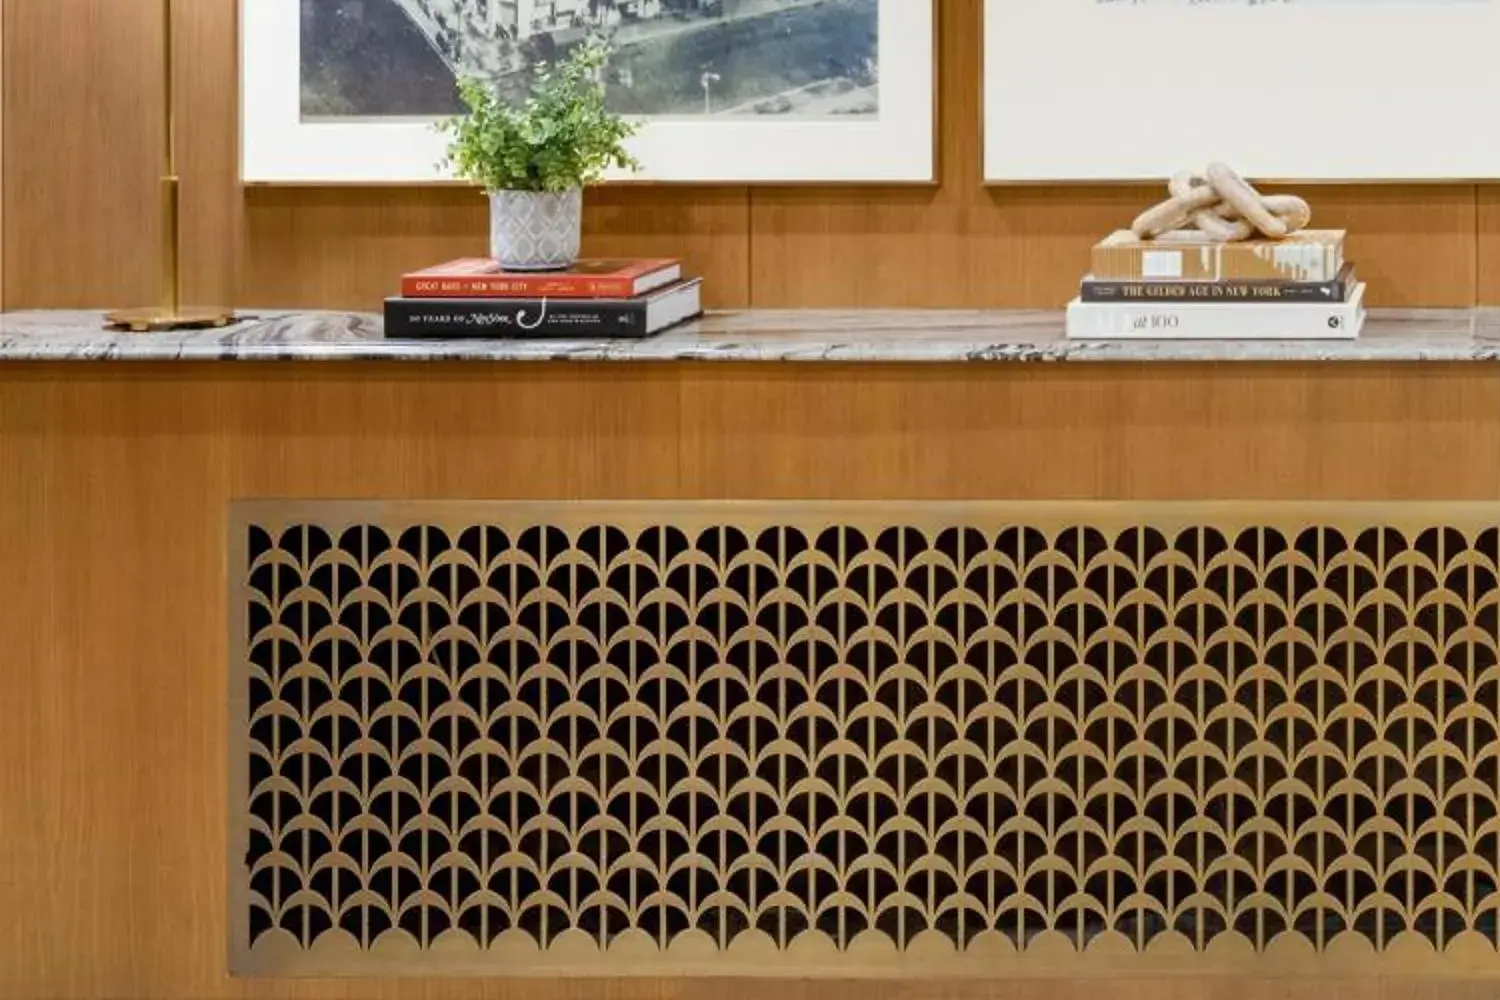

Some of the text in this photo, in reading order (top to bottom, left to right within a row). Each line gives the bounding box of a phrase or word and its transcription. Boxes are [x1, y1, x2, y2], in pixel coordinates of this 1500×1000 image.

[1122, 285, 1144, 297] THE
[1188, 285, 1210, 297] AGE
[1225, 285, 1249, 297] NEW
[1252, 285, 1281, 297] YORK
[1150, 315, 1180, 328] 100
